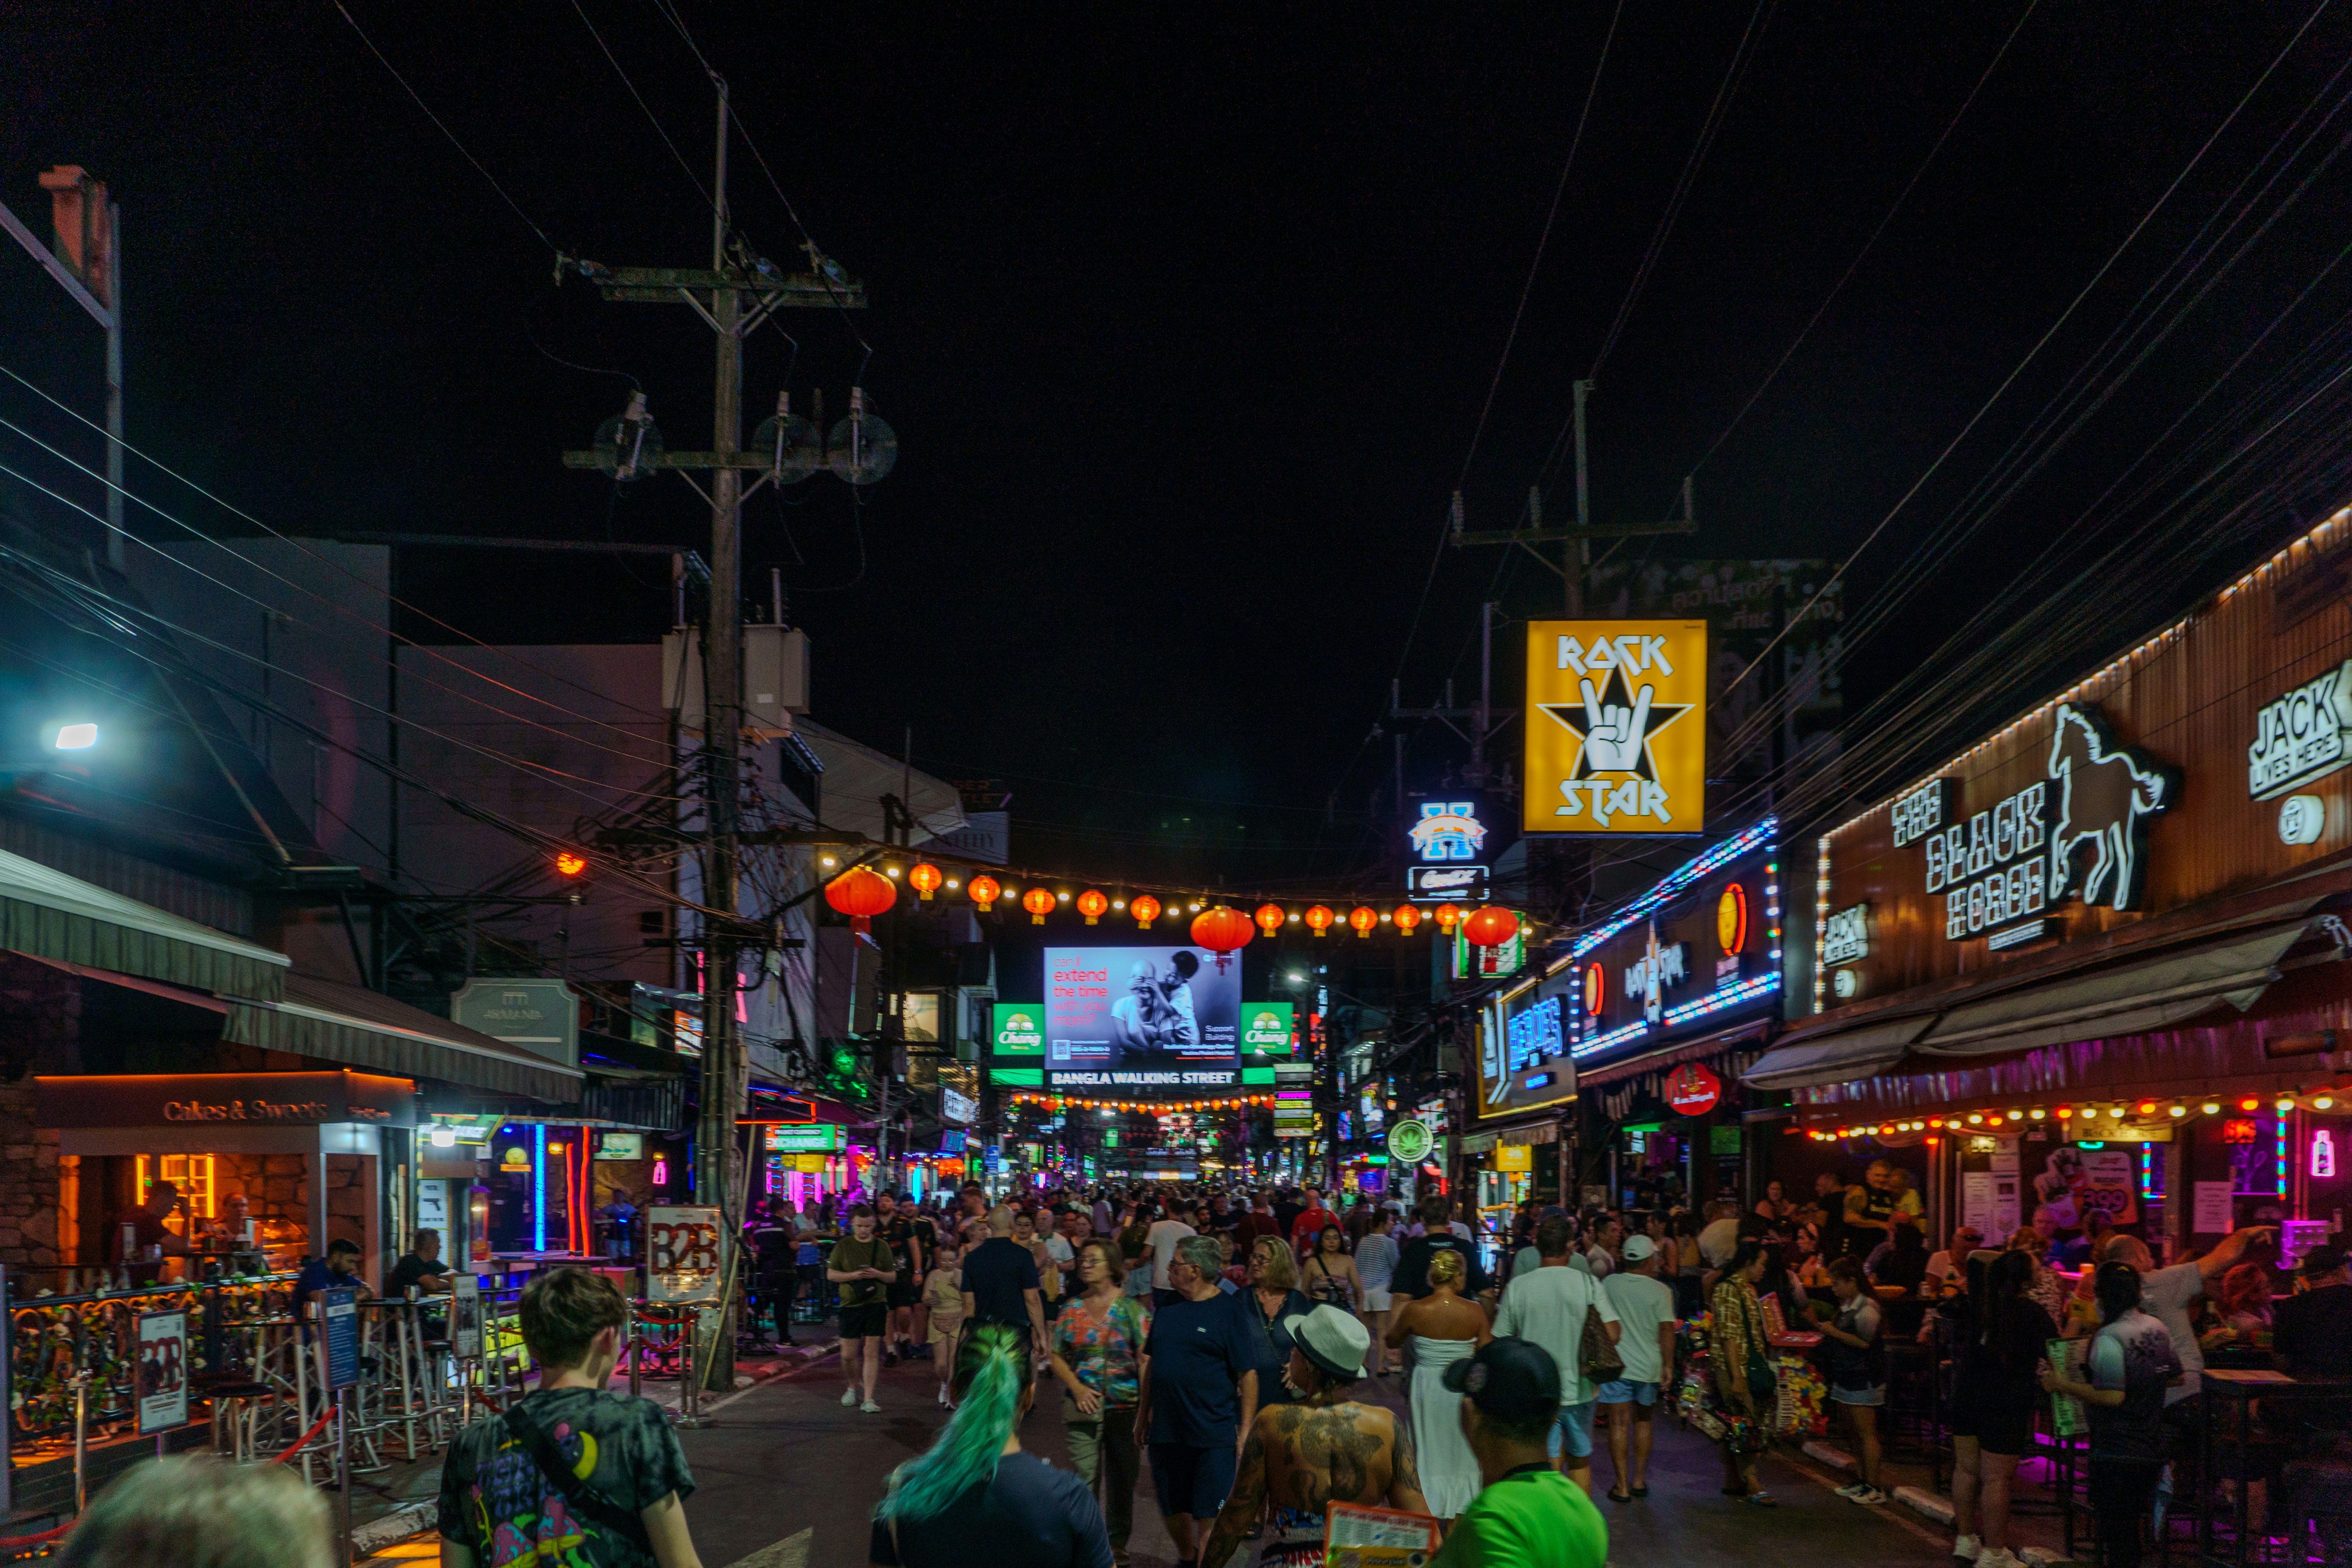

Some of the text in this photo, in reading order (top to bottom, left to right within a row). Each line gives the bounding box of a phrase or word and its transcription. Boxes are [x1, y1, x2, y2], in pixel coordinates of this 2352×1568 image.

[1557, 635, 1674, 677] ROCK
[2255, 675, 2333, 760] JACK
[2256, 733, 2337, 787] LIVES HERE
[1554, 779, 1673, 828] STAR
[1891, 779, 1942, 848] THE
[1926, 782, 2045, 894] BLACK
[1946, 855, 2045, 940] HORSE
[1825, 908, 1857, 944] JACK
[1053, 958, 1073, 967] can
[1053, 967, 1108, 982] extend
[1053, 985, 1108, 998] the time
[1053, 1000, 1105, 1013] with you
[1053, 1013, 1096, 1026] mom?
[998, 1031, 1042, 1047] Chang
[1205, 1033, 1235, 1042] Building
[1245, 1029, 1290, 1045] Chang
[1052, 1071, 1234, 1085] BANGLA WALKING STREET
[163, 1100, 228, 1121] Cakes
[230, 1100, 247, 1121] &
[251, 1100, 328, 1120] Sweets
[766, 1138, 828, 1148] EXCHANGE
[651, 1222, 719, 1276] B2B
